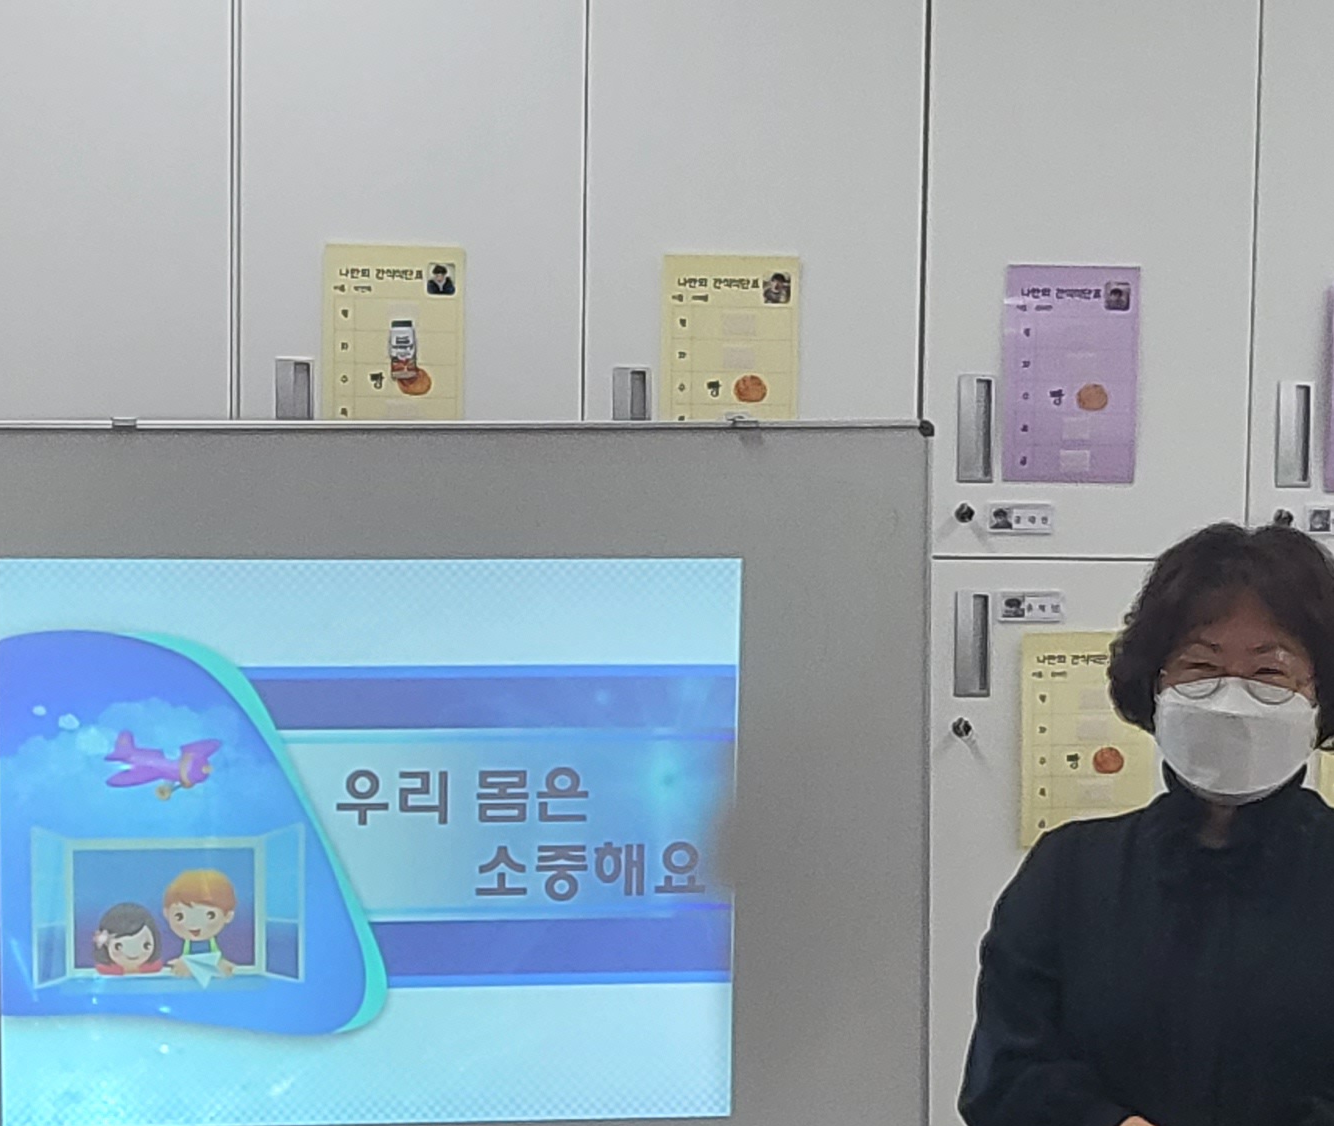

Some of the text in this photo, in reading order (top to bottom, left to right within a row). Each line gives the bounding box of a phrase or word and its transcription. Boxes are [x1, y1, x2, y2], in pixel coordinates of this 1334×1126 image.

[336, 766, 589, 826] 우리 몸은
[475, 841, 706, 901] 소중해요
